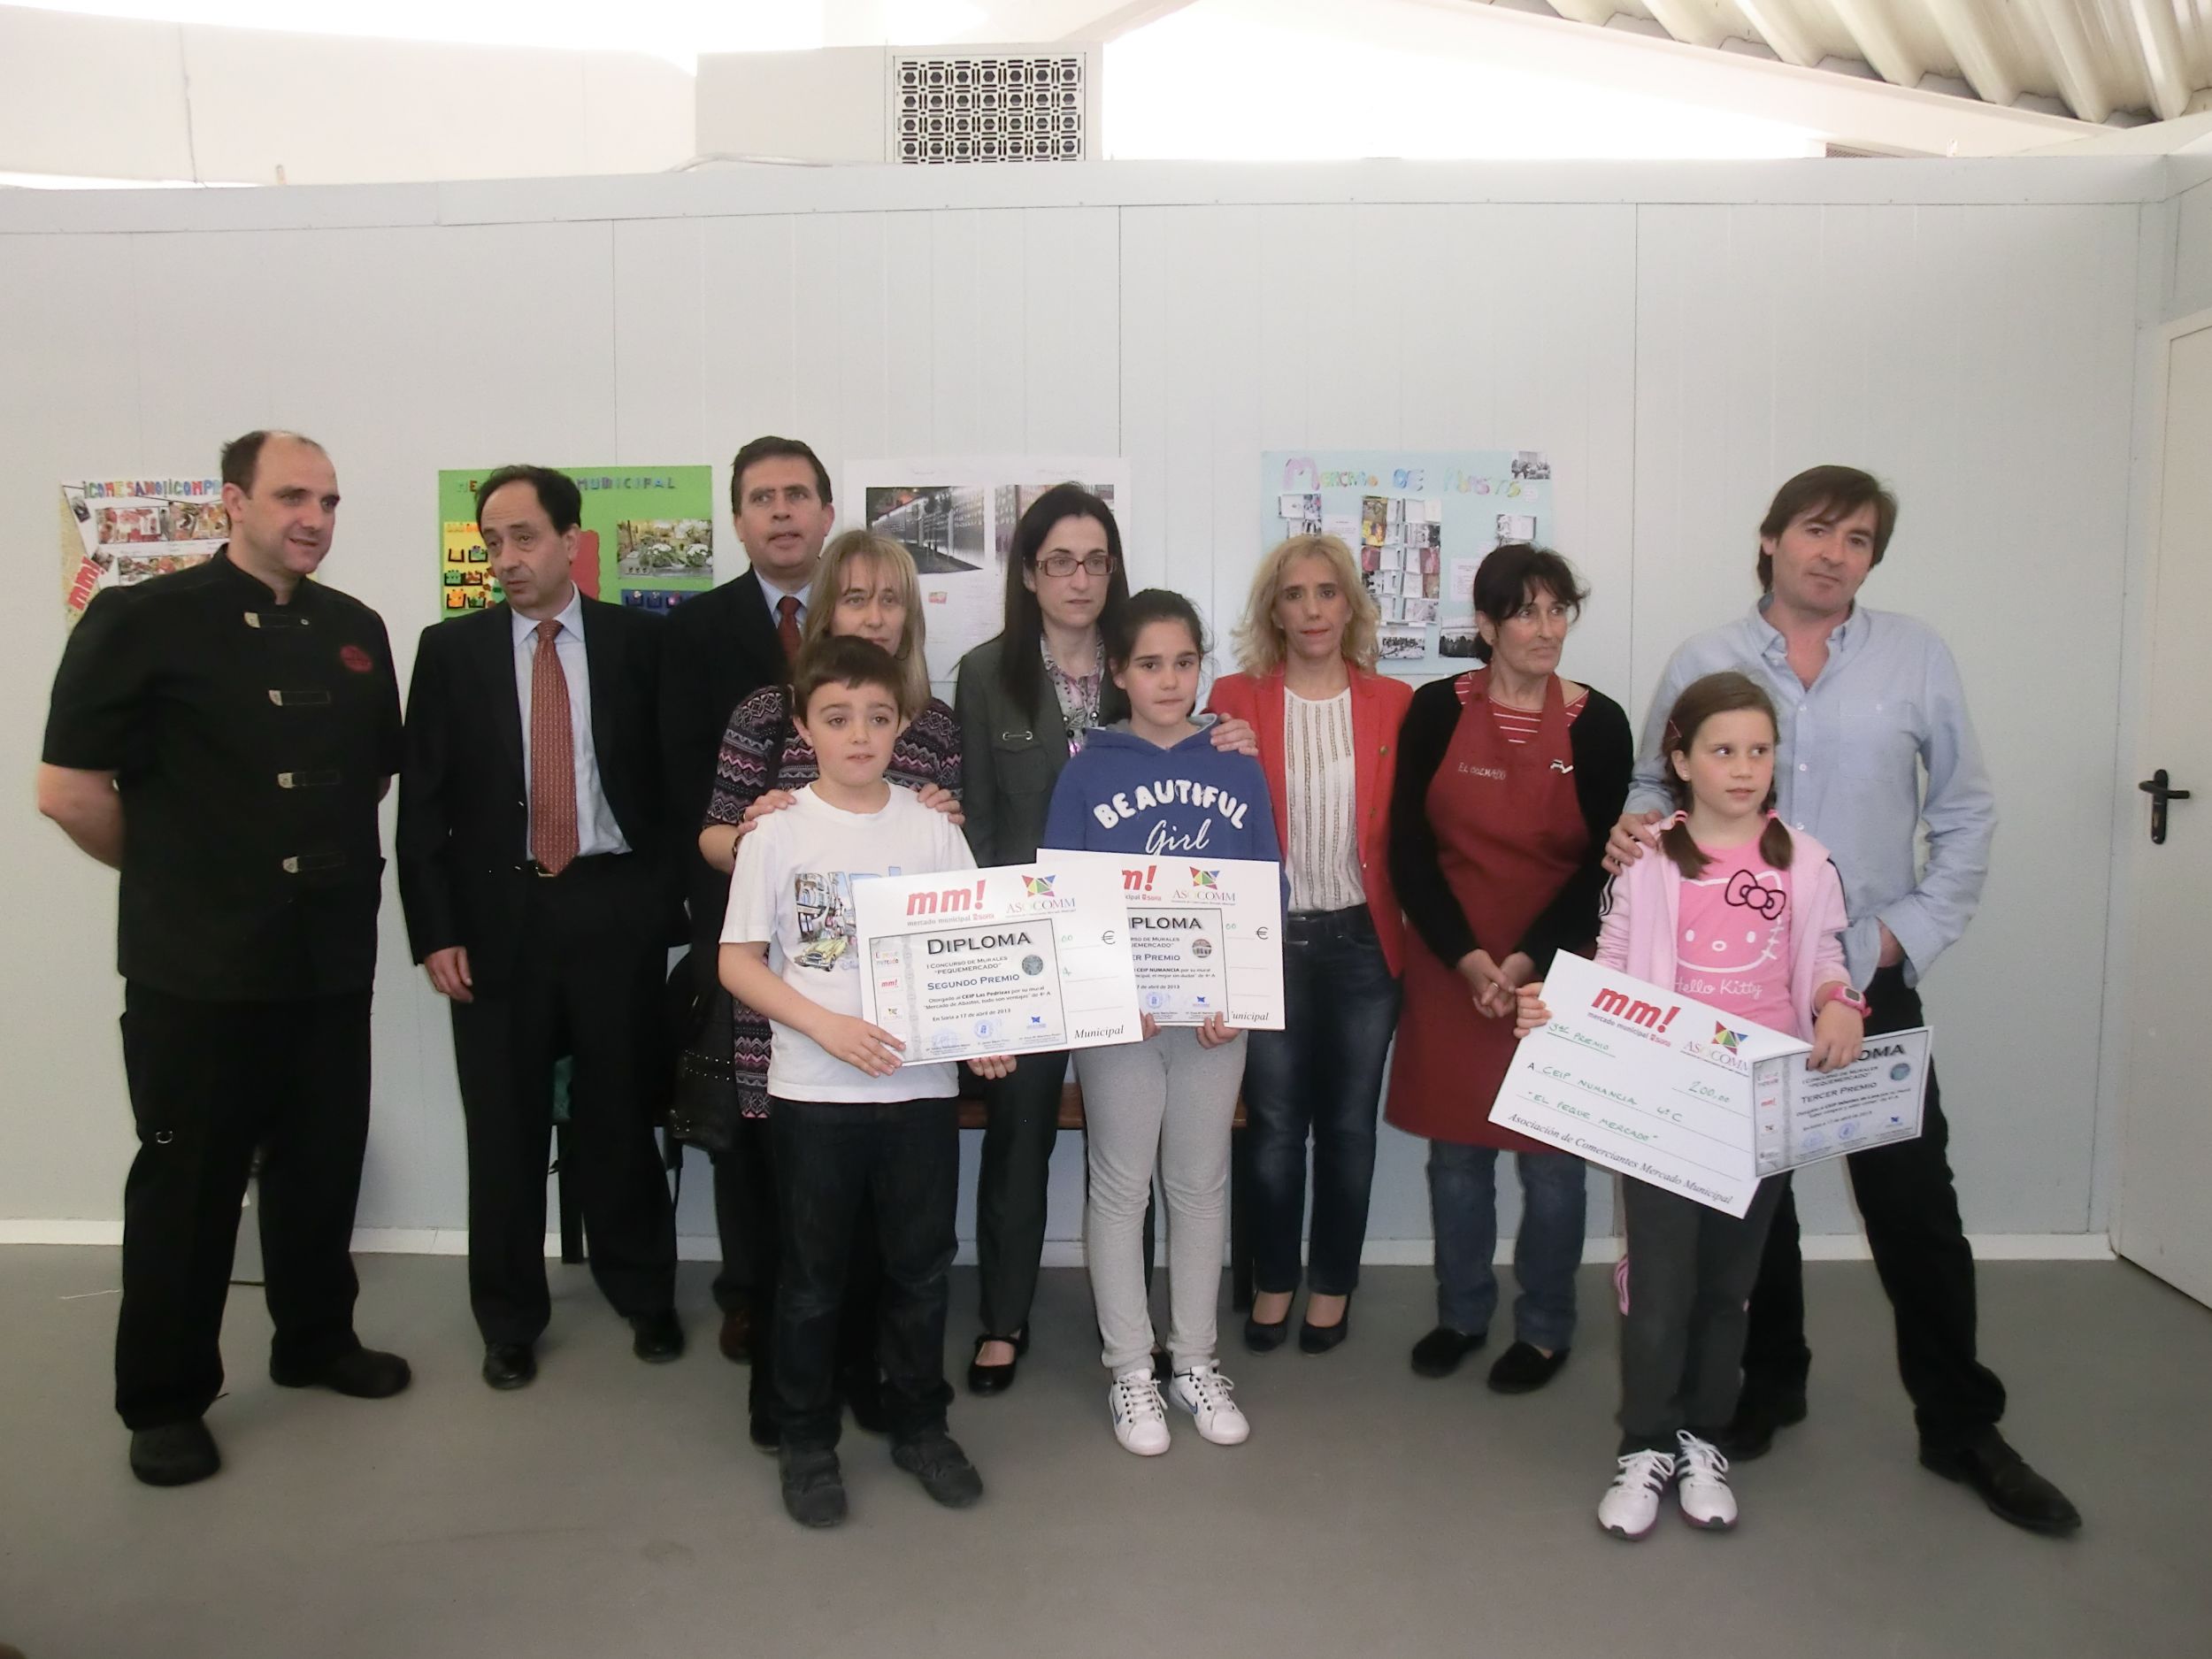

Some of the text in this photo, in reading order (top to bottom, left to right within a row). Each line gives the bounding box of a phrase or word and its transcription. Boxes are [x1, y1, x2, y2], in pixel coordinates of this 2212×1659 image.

[1094, 780, 1248, 829] BEAUTIFUL
[1145, 818, 1212, 856] Girl
[907, 879, 986, 915] mm!
[907, 918, 936, 927] mercado
[939, 914, 971, 925] municipal
[1131, 917, 1202, 929] PLOMA
[1102, 930, 1116, 945] €
[1256, 926, 1269, 940] €
[927, 932, 1032, 956] DIPLOMA
[930, 960, 966, 969] CONCURSO
[881, 979, 898, 987] mm!
[927, 973, 1020, 991] SEGUNDO PREMIO
[1720, 979, 1763, 1000] Kitty
[1231, 1011, 1269, 1022] unicipal
[1591, 987, 1681, 1033] mm!
[1075, 1025, 1124, 1039] Municipal
[1587, 1011, 1616, 1026] mercado
[1617, 1023, 1648, 1039] municipal
[1573, 1032, 1609, 1051] PREMIO
[1528, 1063, 1535, 1071] A
[1543, 1066, 1571, 1080] CEIP
[1578, 1079, 1639, 1106] NUMANCIA
[1671, 1112, 1683, 1124] C
[1801, 1089, 1839, 1104] TERCER
[1840, 1082, 1878, 1094] PREMIO
[1557, 1101, 1591, 1120] PEQUE
[1508, 1113, 1732, 1204] Asociación de Comerciantes Mercado Municipal
